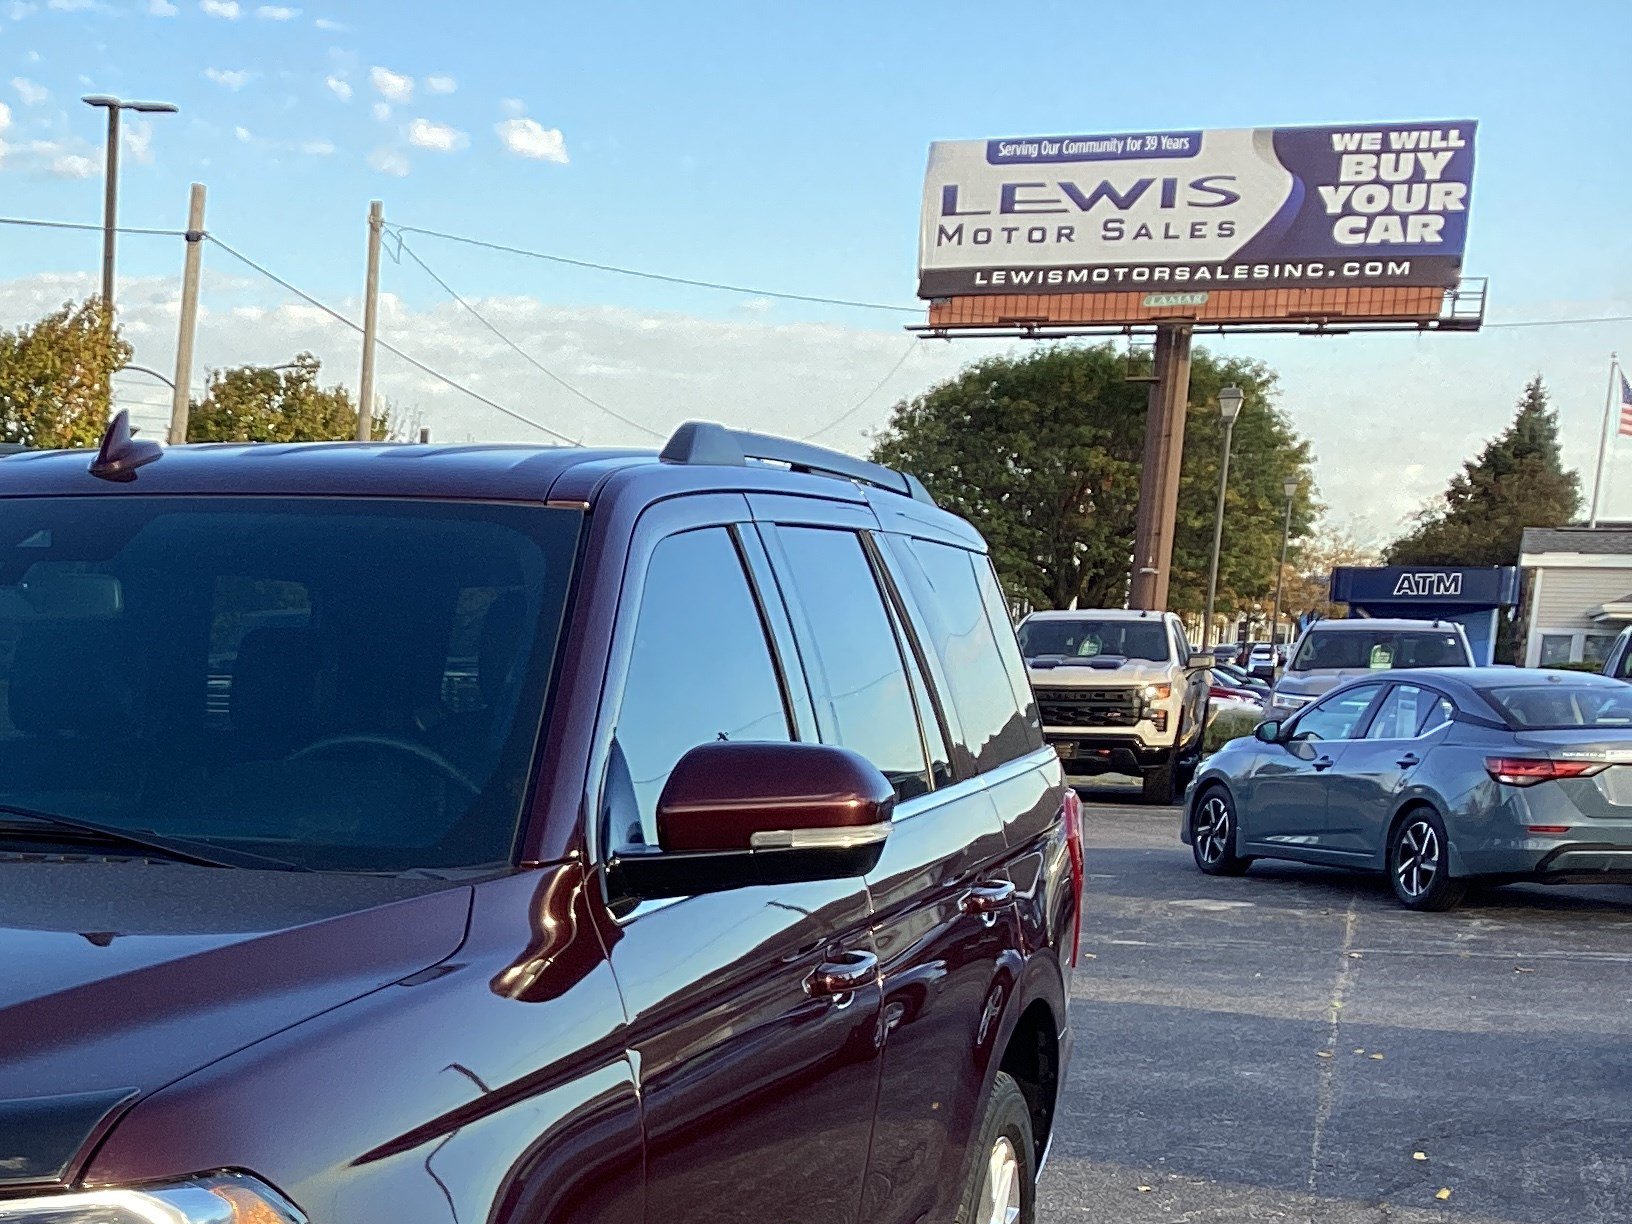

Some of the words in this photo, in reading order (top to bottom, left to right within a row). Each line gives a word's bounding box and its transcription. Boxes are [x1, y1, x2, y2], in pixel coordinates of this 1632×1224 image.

[998, 141, 1038, 158] Serving
[1041, 141, 1059, 156] Our
[1062, 138, 1123, 156] Community
[1126, 137, 1143, 151] for
[1144, 137, 1157, 151] 39
[1160, 135, 1190, 151] Years
[1332, 132, 1382, 151] WE
[1389, 129, 1466, 149] WILL
[1340, 151, 1455, 183] BUY
[941, 175, 1242, 217] LEWIS
[1317, 182, 1467, 214] YOUR
[937, 223, 1075, 248] MOTOR
[1102, 218, 1236, 242] SALES
[1333, 214, 1445, 245] CAR
[975, 261, 1411, 286] LEWISMOTORSALESINC.COM
[1393, 572, 1463, 596] ATM
